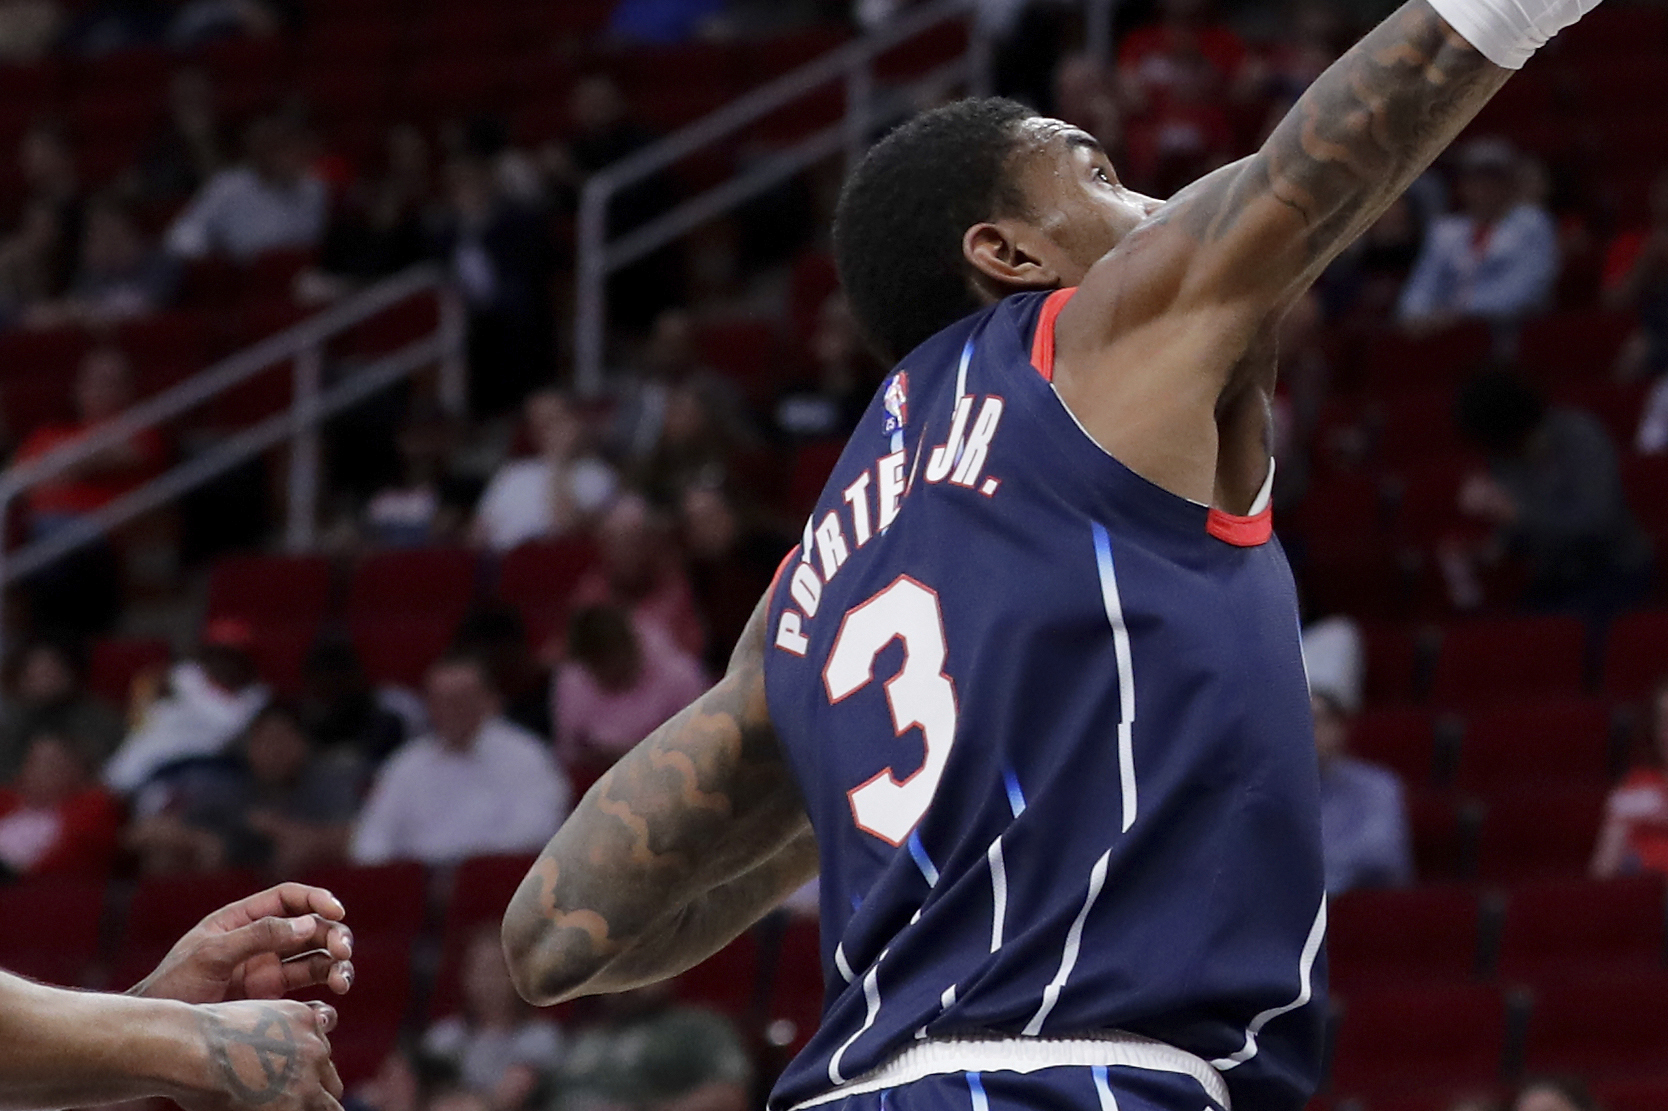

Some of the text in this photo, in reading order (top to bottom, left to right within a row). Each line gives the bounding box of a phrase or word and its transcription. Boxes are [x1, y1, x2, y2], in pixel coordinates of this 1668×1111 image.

[775, 394, 1005, 657] PORTE JR.
[822, 573, 960, 848] 3
